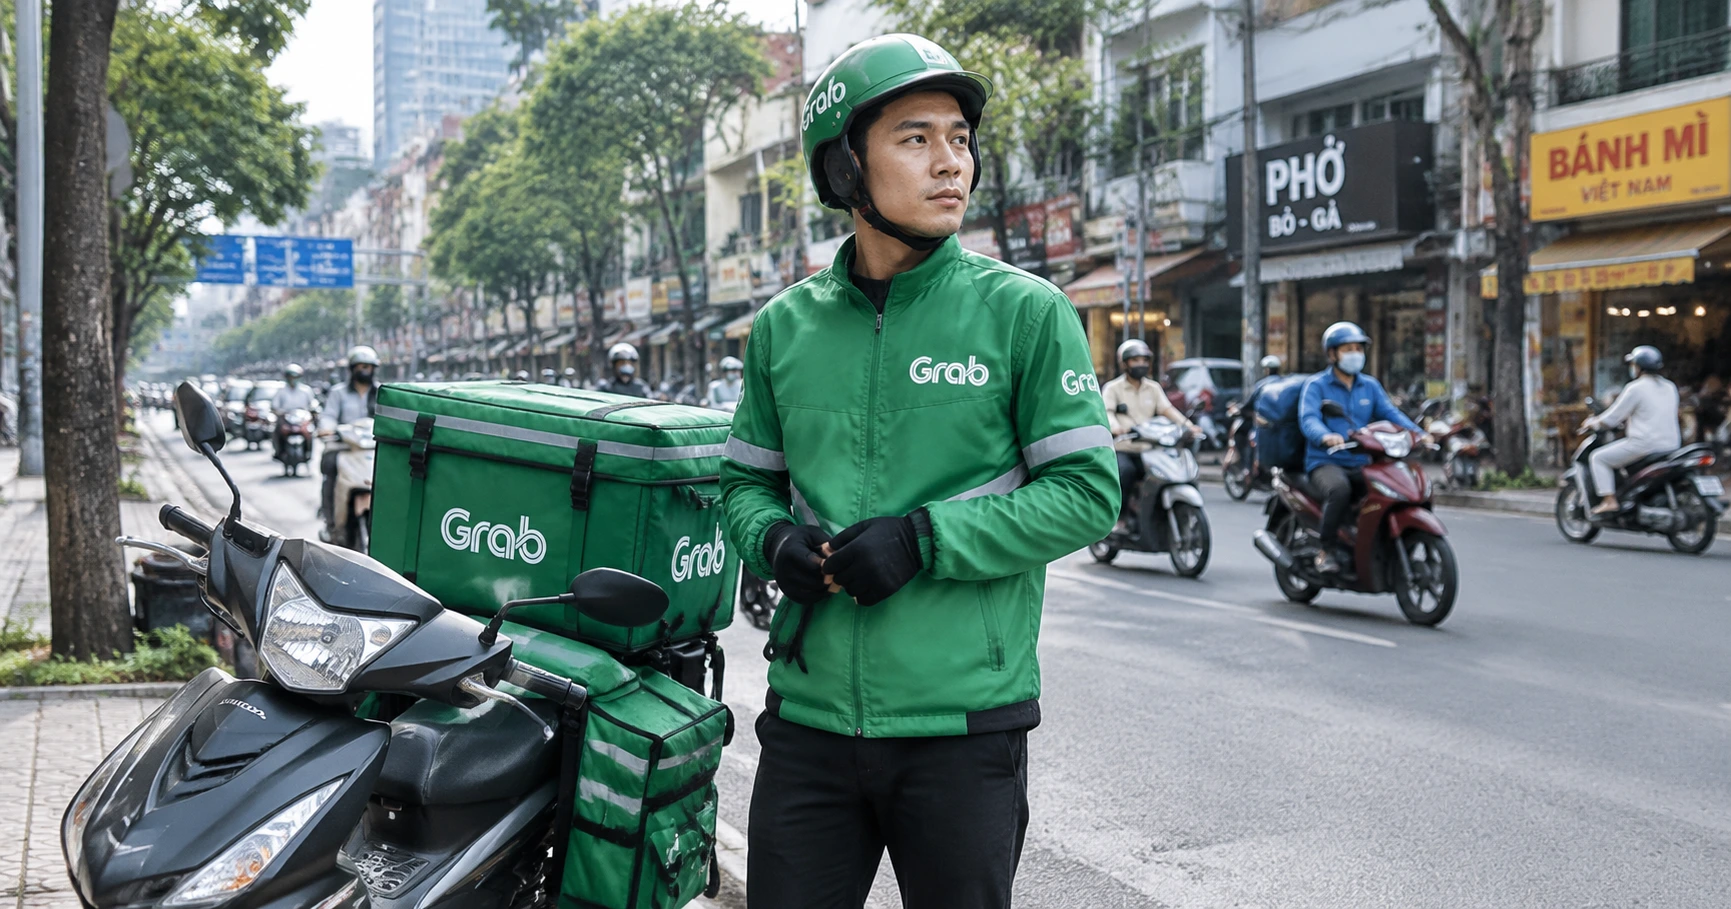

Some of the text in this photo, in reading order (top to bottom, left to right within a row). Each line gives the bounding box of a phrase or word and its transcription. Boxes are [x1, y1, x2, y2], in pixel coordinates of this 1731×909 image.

[1266, 134, 1346, 206] PHỞ
[1549, 110, 1709, 181] BÁNH MÌ
[1627, 174, 1673, 197] NAM
[909, 355, 990, 386] Grab
[1061, 369, 1099, 396] Gra
[440, 507, 547, 565] Grab
[671, 521, 725, 583] Grab
